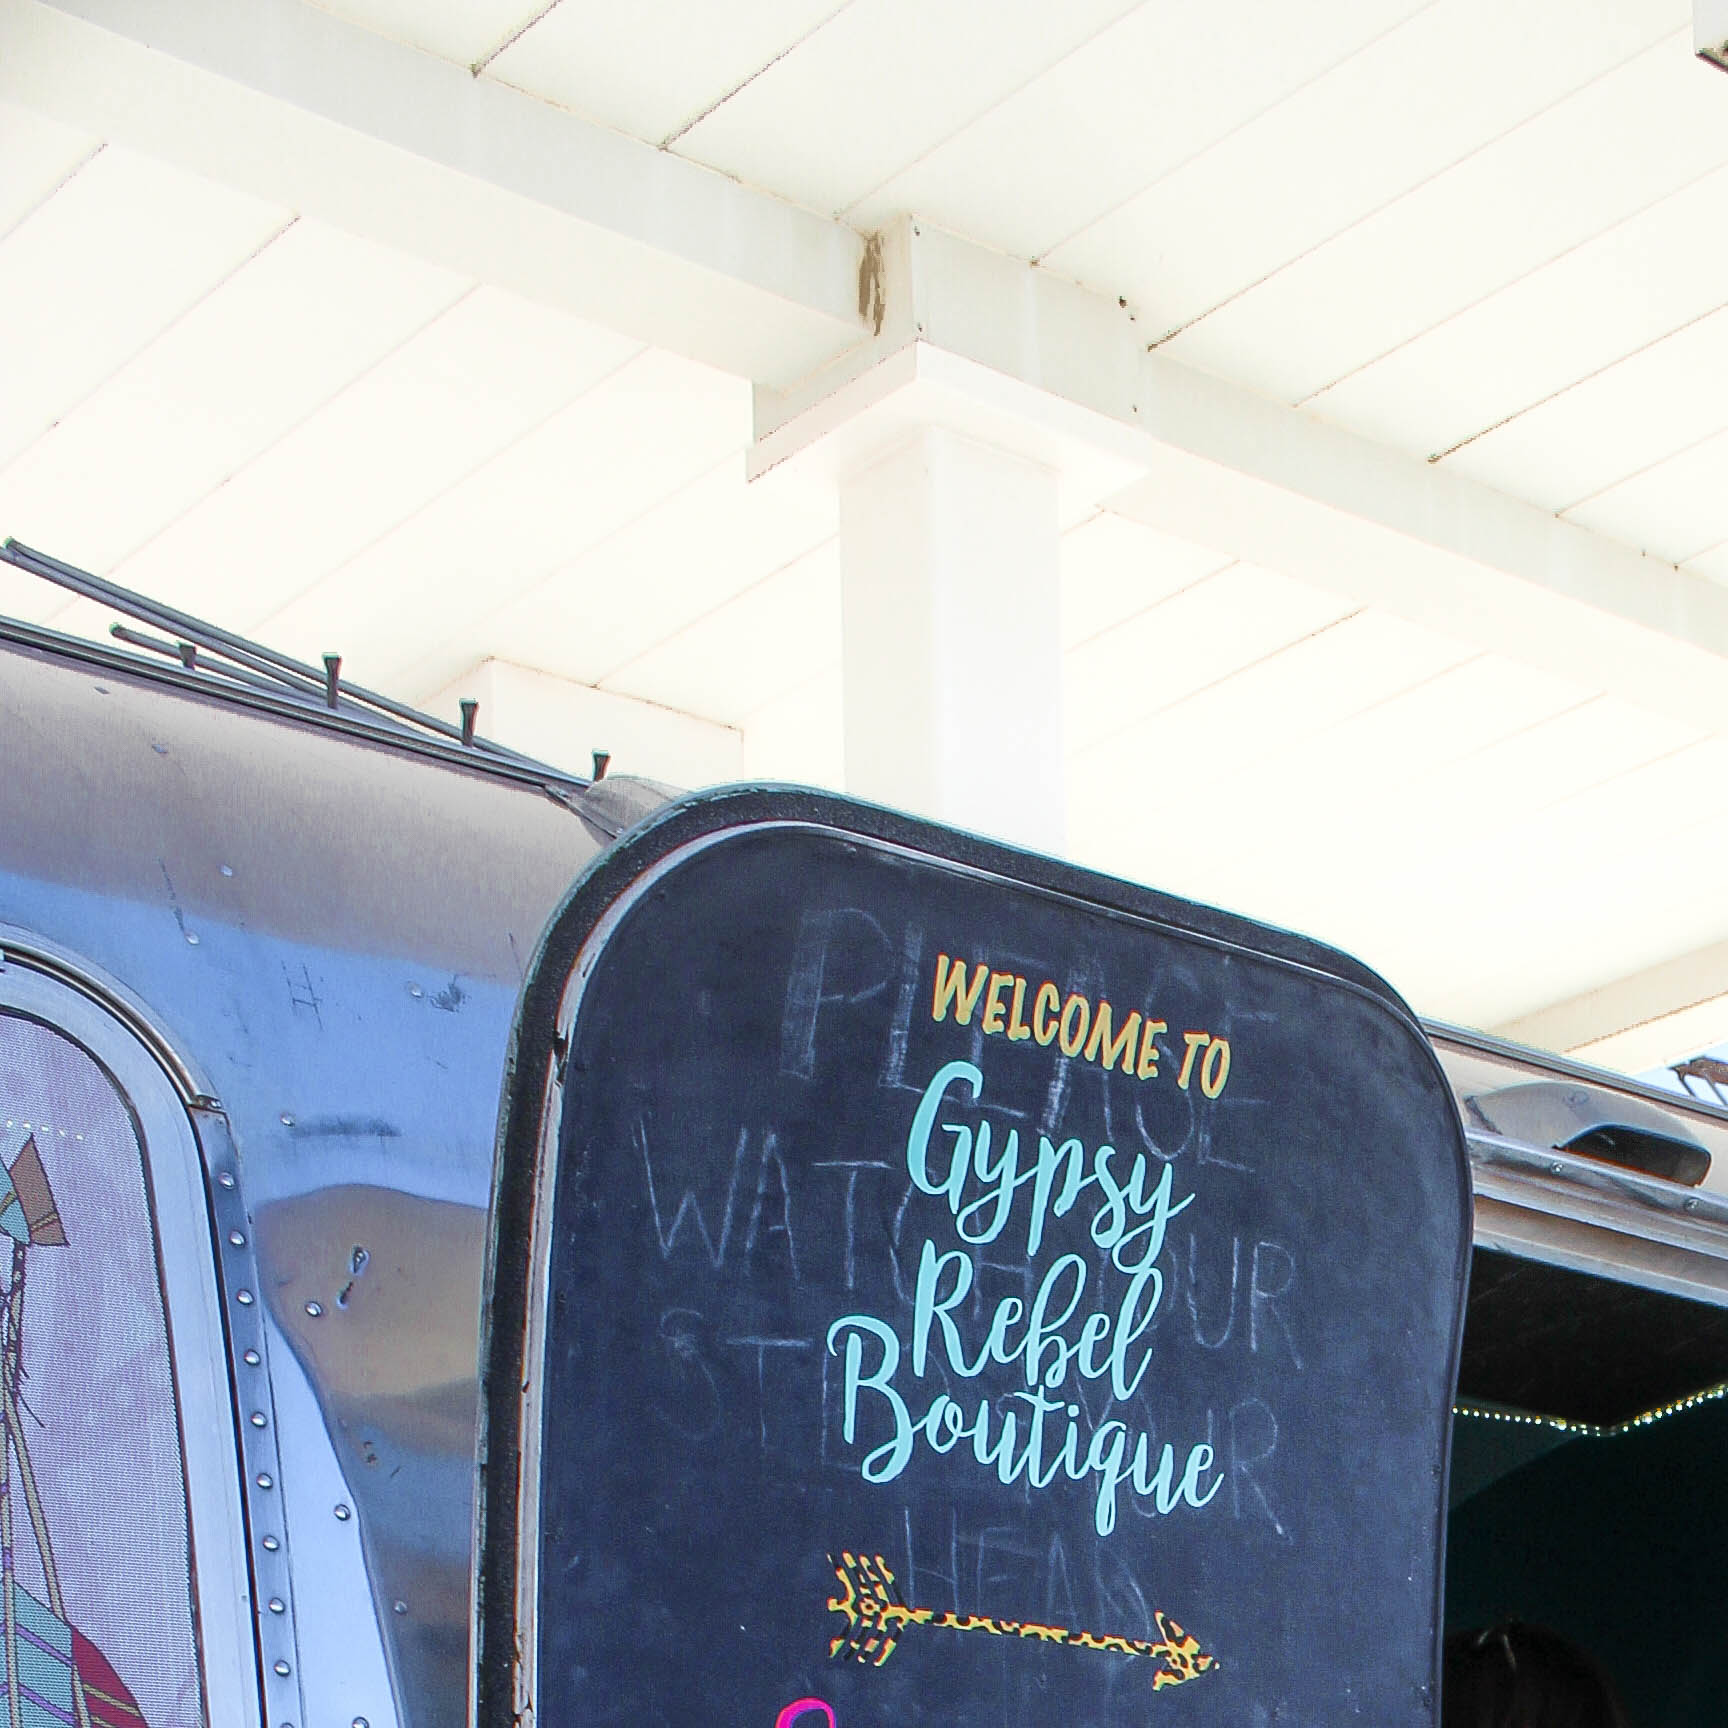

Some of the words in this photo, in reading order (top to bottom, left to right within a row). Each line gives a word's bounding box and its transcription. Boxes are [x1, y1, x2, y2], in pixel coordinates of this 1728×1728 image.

[932, 953, 1167, 1076] WELCOME
[1177, 1030, 1230, 1099] TO
[905, 1060, 1196, 1275] Gypsy
[911, 1238, 1166, 1402] Rebel
[826, 1313, 1227, 1537] Boutique
